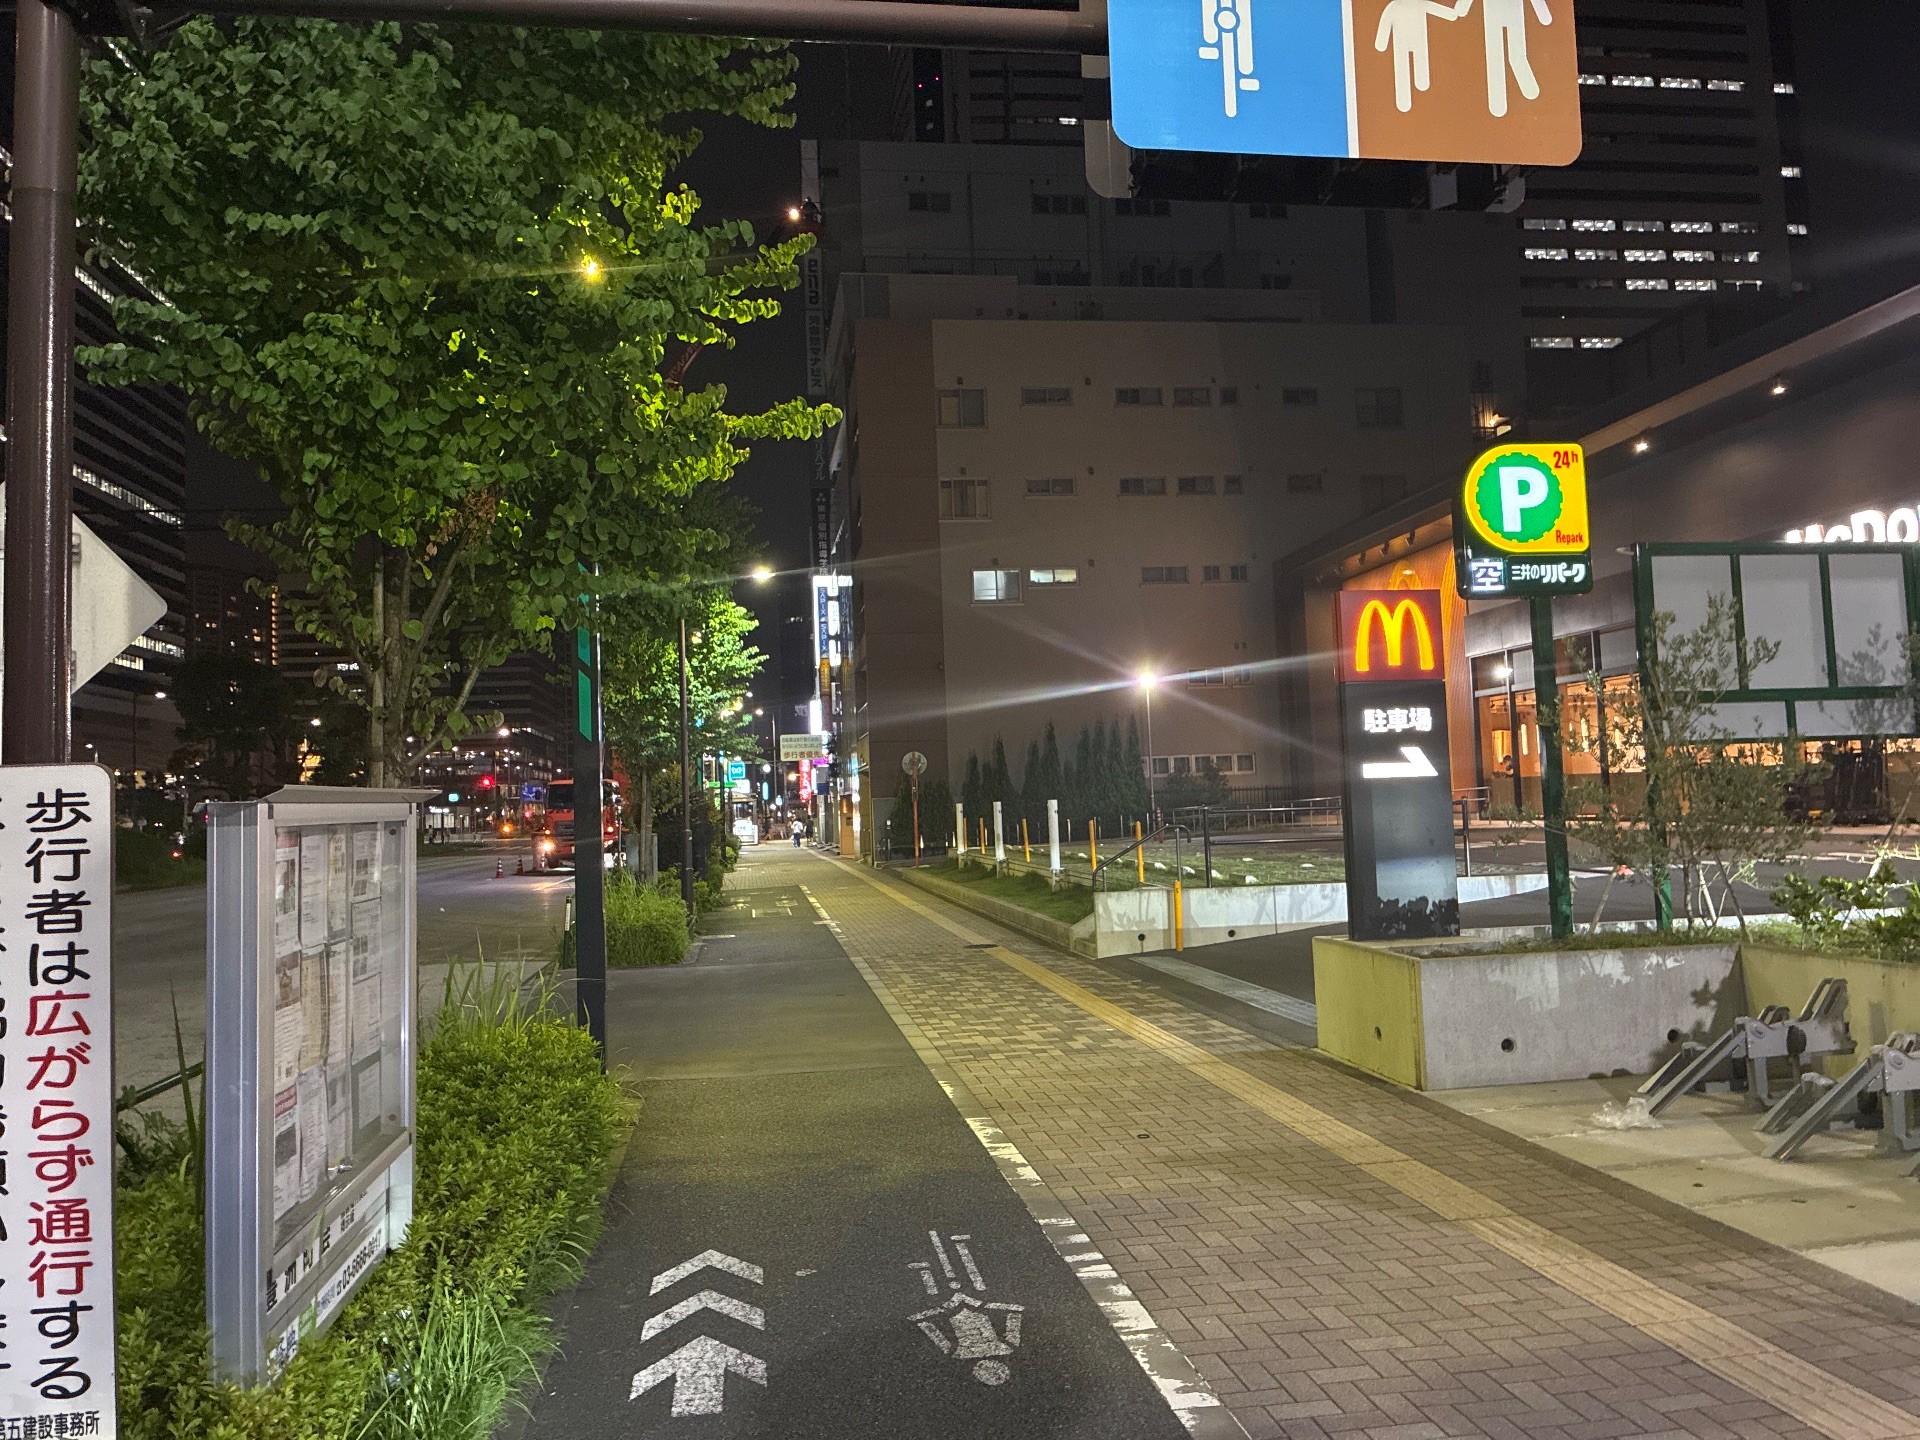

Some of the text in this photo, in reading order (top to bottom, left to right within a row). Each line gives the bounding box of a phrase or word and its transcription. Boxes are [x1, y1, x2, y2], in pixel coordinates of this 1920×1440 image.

[1498, 466, 1549, 533] P
[1555, 530, 1584, 545] Repark
[1471, 558, 1505, 591] 空
[1511, 563, 1586, 583] 三井のリパーク
[819, 588, 827, 616] SAPIX
[820, 624, 828, 652] SAPIX
[1364, 707, 1432, 732] 駐車場
[25, 788, 94, 1400] 歩行者は広がらず通行する
